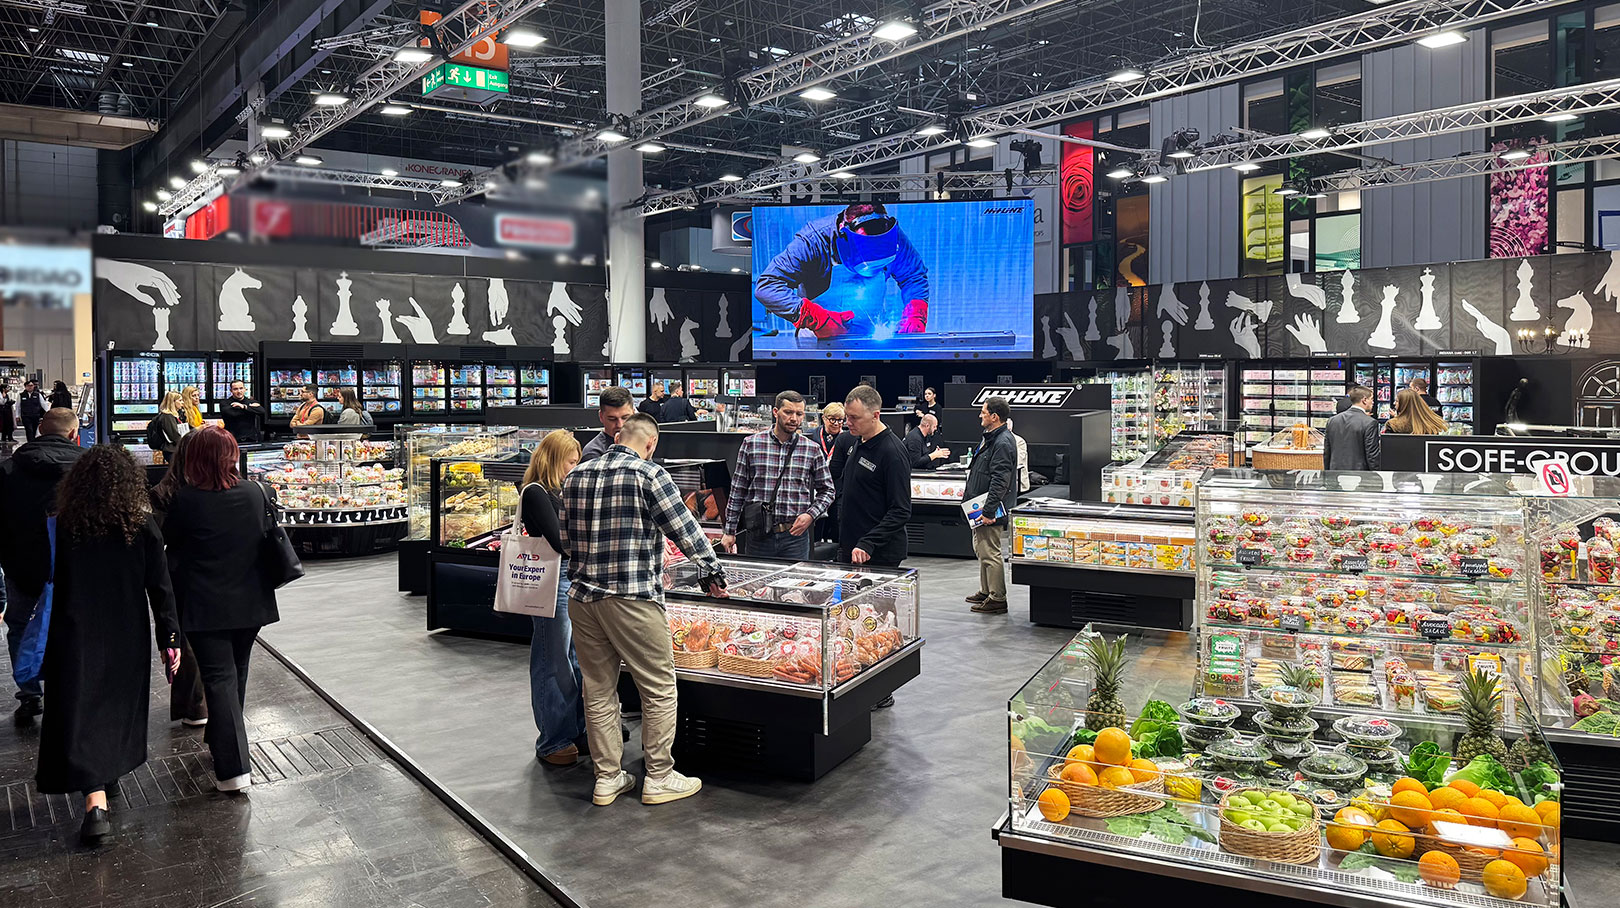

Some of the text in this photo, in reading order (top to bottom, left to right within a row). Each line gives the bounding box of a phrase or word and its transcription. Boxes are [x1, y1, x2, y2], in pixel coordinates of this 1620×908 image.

[489, 80, 508, 89] Ausgang
[407, 163, 467, 177] KONECRANE
[509, 563, 545, 573] Your Expert
[511, 571, 541, 582] in Europe
